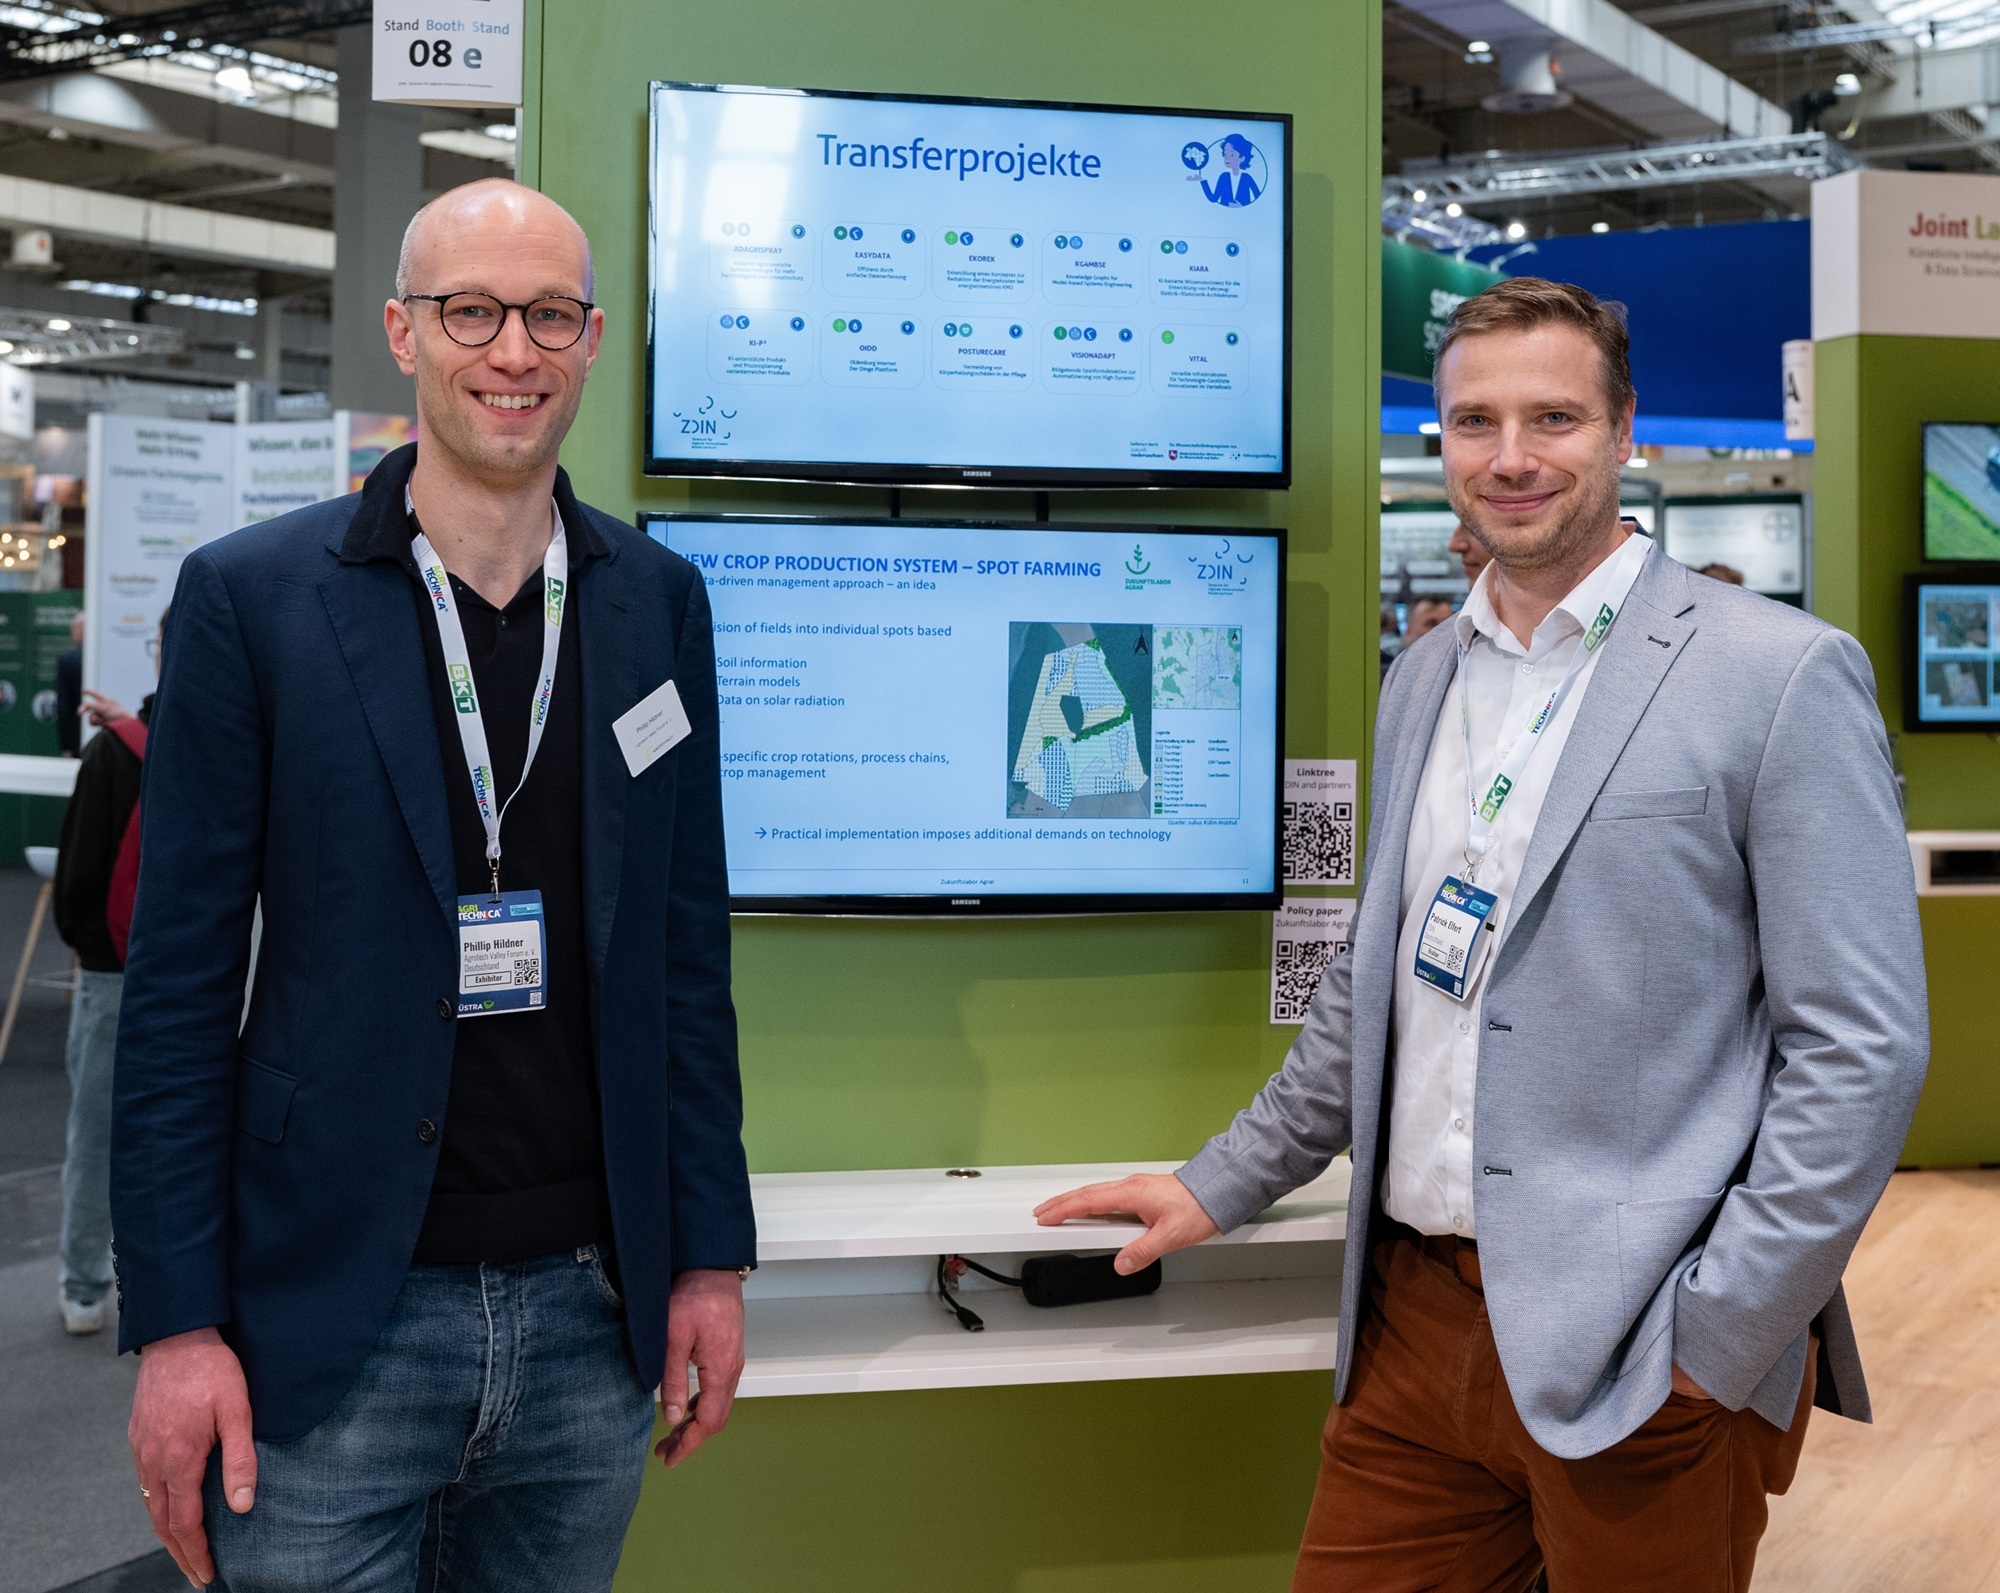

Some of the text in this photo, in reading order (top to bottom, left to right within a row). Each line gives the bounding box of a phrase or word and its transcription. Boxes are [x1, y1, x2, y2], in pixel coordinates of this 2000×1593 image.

[384, 19, 509, 35] Stand Booth Stand
[409, 39, 482, 69] 08 e
[817, 134, 1101, 181] Transferprojekte
[1909, 212, 2000, 240] Joint La
[733, 246, 783, 254] ADAGRISPRAY
[855, 252, 892, 260] EASYDATA
[969, 255, 996, 263] EKOREK
[1189, 265, 1209, 273] KIARA
[958, 348, 1006, 357] POSTURECARE
[1071, 352, 1116, 360] VISIONADAPT
[1189, 355, 1208, 363] VITAL
[1786, 371, 1800, 403] A
[723, 554, 770, 570] CROP
[775, 556, 888, 572] PRODUCTION
[893, 558, 958, 574] SYSTEM
[977, 560, 1019, 575] SPOT
[1024, 561, 1101, 577] FARMING
[433, 565, 447, 585] AGRI
[704, 576, 753, 587] ta-driven
[757, 577, 830, 589] management
[833, 578, 884, 590] approach
[897, 581, 910, 589] an
[913, 579, 936, 590] idea
[546, 576, 565, 627] BKT
[713, 621, 952, 638] ision of fields into individual spots based
[1584, 602, 1614, 652] BKT
[716, 657, 807, 669] Soil information
[717, 675, 801, 687] Terrain models
[448, 663, 477, 714] BKT
[718, 695, 845, 707] Data on solar radiation
[771, 753, 798, 764] crop
[801, 752, 858, 764] rotations,
[862, 753, 906, 765] process
[909, 752, 950, 764] chains,
[480, 765, 491, 791] AGRI
[747, 768, 826, 780] management
[1297, 768, 1335, 777] Linktree
[1285, 781, 1351, 790] DIN and partners
[1480, 772, 1513, 824] BKT
[772, 828, 1172, 842] Practical implementation imposes additional demands on technology
[980, 878, 995, 886] Agrar
[458, 904, 478, 914] AGRI
[1287, 906, 1343, 917] Policy paper
[1275, 919, 1350, 929] Zukunftslabor Agra
[1430, 912, 1448, 928] Patrick
[463, 939, 524, 952] Phillip Hildner
[464, 952, 489, 963] Agrotech
[490, 951, 506, 961] Valley
[506, 950, 524, 959] Forum
[464, 962, 500, 973] Deutschland
[475, 974, 502, 984] Exhibitor
[458, 1003, 483, 1012] ÜSTRA
